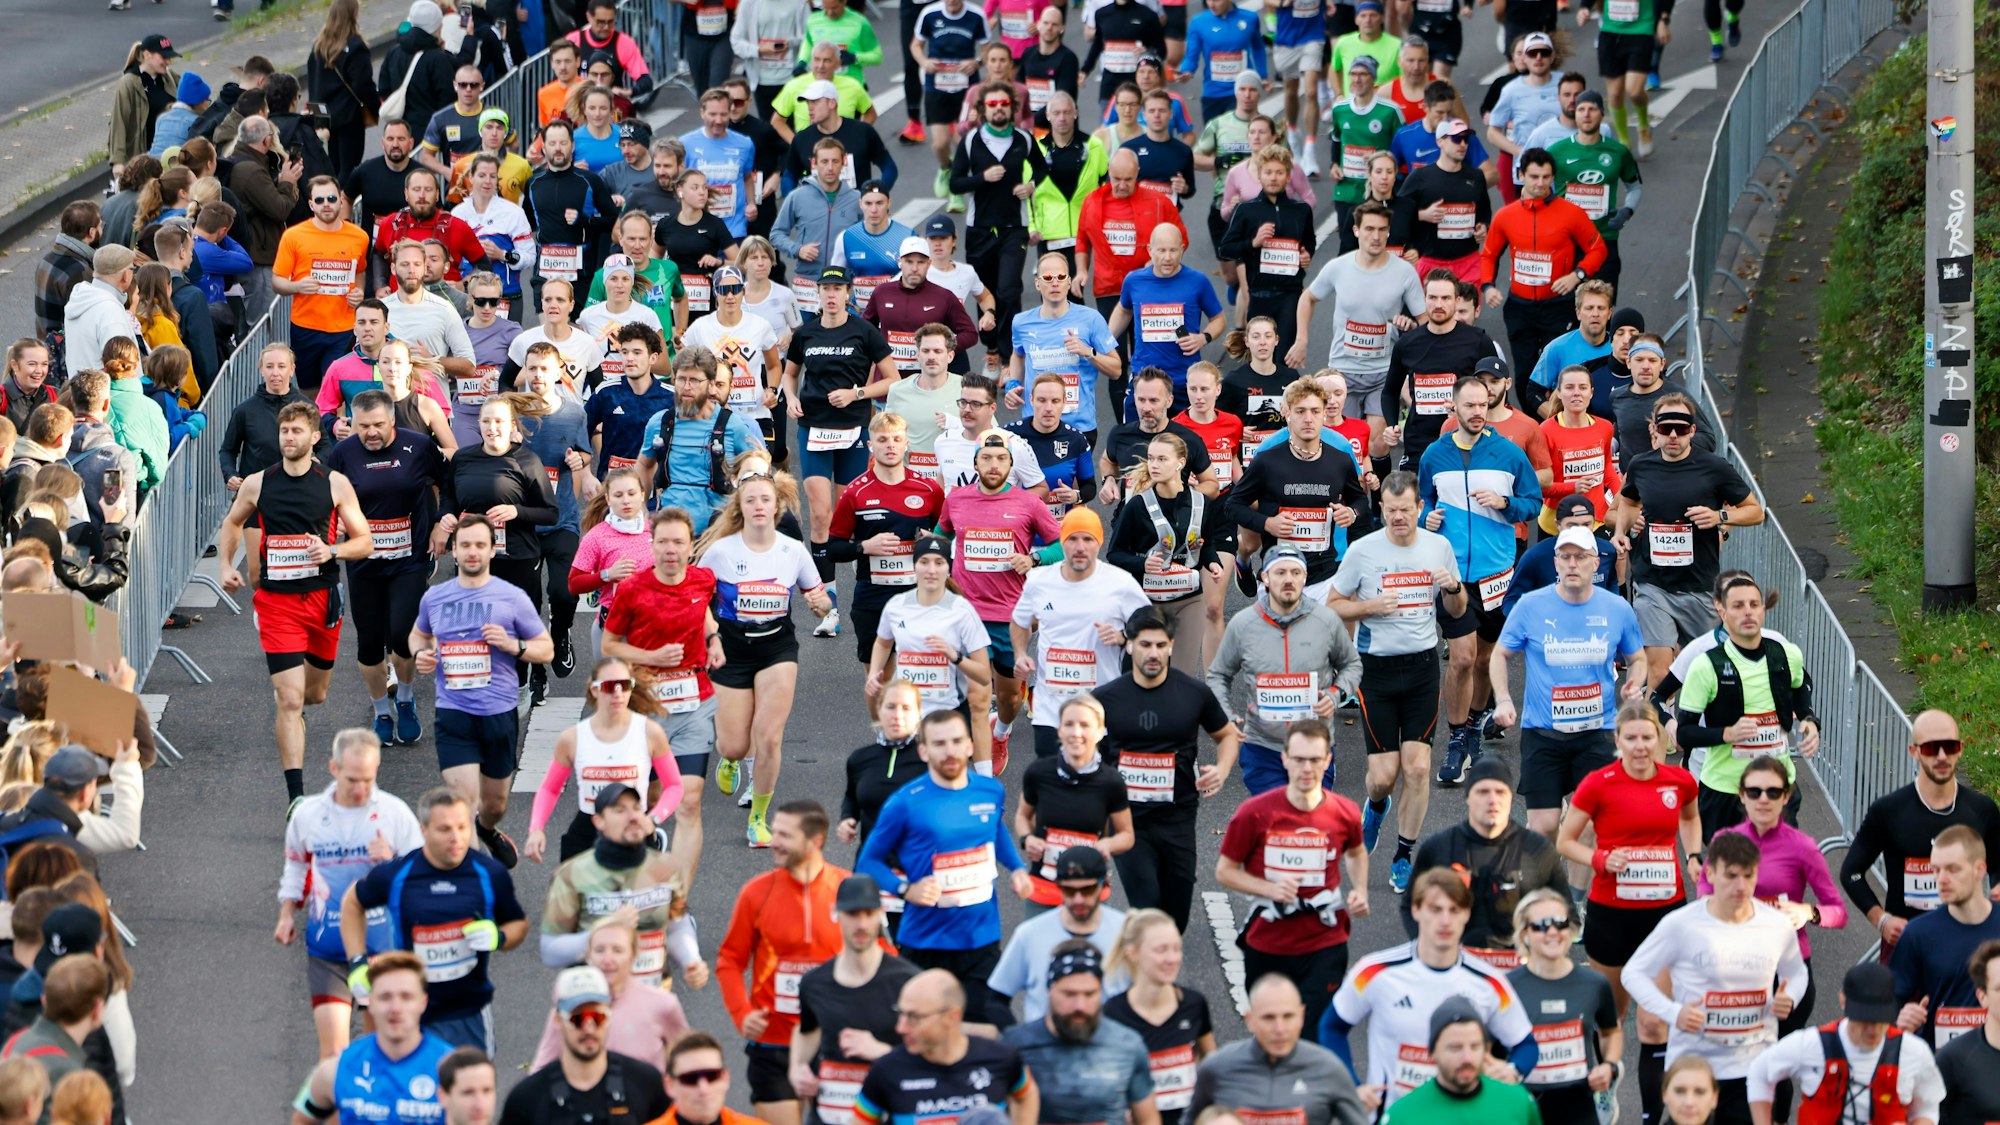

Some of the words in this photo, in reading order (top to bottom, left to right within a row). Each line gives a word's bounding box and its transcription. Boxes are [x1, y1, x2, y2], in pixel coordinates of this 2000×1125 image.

[548, 248, 577, 256] GENERALI
[1263, 250, 1294, 262] Daniel
[1523, 250, 1551, 260] GENERALI
[321, 260, 351, 270] GENERALI
[543, 259, 569, 270] Björn
[1516, 262, 1543, 274] Justin
[312, 272, 346, 282] Richard
[686, 290, 702, 298] ula
[1151, 305, 1183, 315] GENERALI
[1142, 317, 1178, 328] Patrick
[1356, 323, 1386, 334] GENERALI
[1351, 335, 1374, 346] Paul
[1424, 374, 1457, 385] GENERALI
[1415, 388, 1452, 399] Carsten
[816, 430, 842, 441] Julia
[1573, 446, 1603, 459] GENERALI
[1564, 461, 1601, 475] Nadine
[1284, 482, 1331, 496] GYMSHARK
[1292, 511, 1326, 521] GENERALI
[375, 520, 410, 532] GENERALI
[1296, 524, 1311, 535] im
[373, 534, 406, 546] homas
[975, 530, 1012, 540] GENERALI
[1654, 535, 1685, 545] 14246
[965, 541, 1007, 556] Rodrigo
[880, 559, 903, 569] Ben
[1144, 577, 1162, 586] Sina
[1164, 577, 1188, 587] Malin
[1396, 573, 1432, 585] GENERALI
[749, 583, 788, 595] GENERALI
[1397, 592, 1428, 601] Carsten
[738, 596, 781, 610] Melina
[440, 601, 493, 628] RUN
[450, 644, 488, 655] GENERALI
[1546, 646, 1606, 655] HALBMARATHON
[909, 655, 947, 664] GENERALI
[1058, 651, 1094, 662] GENERALI
[442, 660, 484, 671] Christian
[902, 668, 937, 683] Synje
[1053, 666, 1081, 679] Eike
[1269, 674, 1309, 686] GENERALI
[656, 684, 683, 698] Karl
[1259, 691, 1302, 703] Simon
[1564, 685, 1601, 699] GENERALI
[1553, 703, 1599, 716] Marcus
[1134, 756, 1173, 768] GENERALI
[595, 767, 637, 779] GENERALI
[1120, 772, 1167, 786] Serkan
[1280, 852, 1303, 865] Ivo
[1632, 848, 1673, 860] GENERALI
[1618, 866, 1669, 879] Martina
[426, 946, 459, 962] Dirk
[1721, 993, 1767, 1006] GENERALI
[1706, 1012, 1758, 1026] Florian
